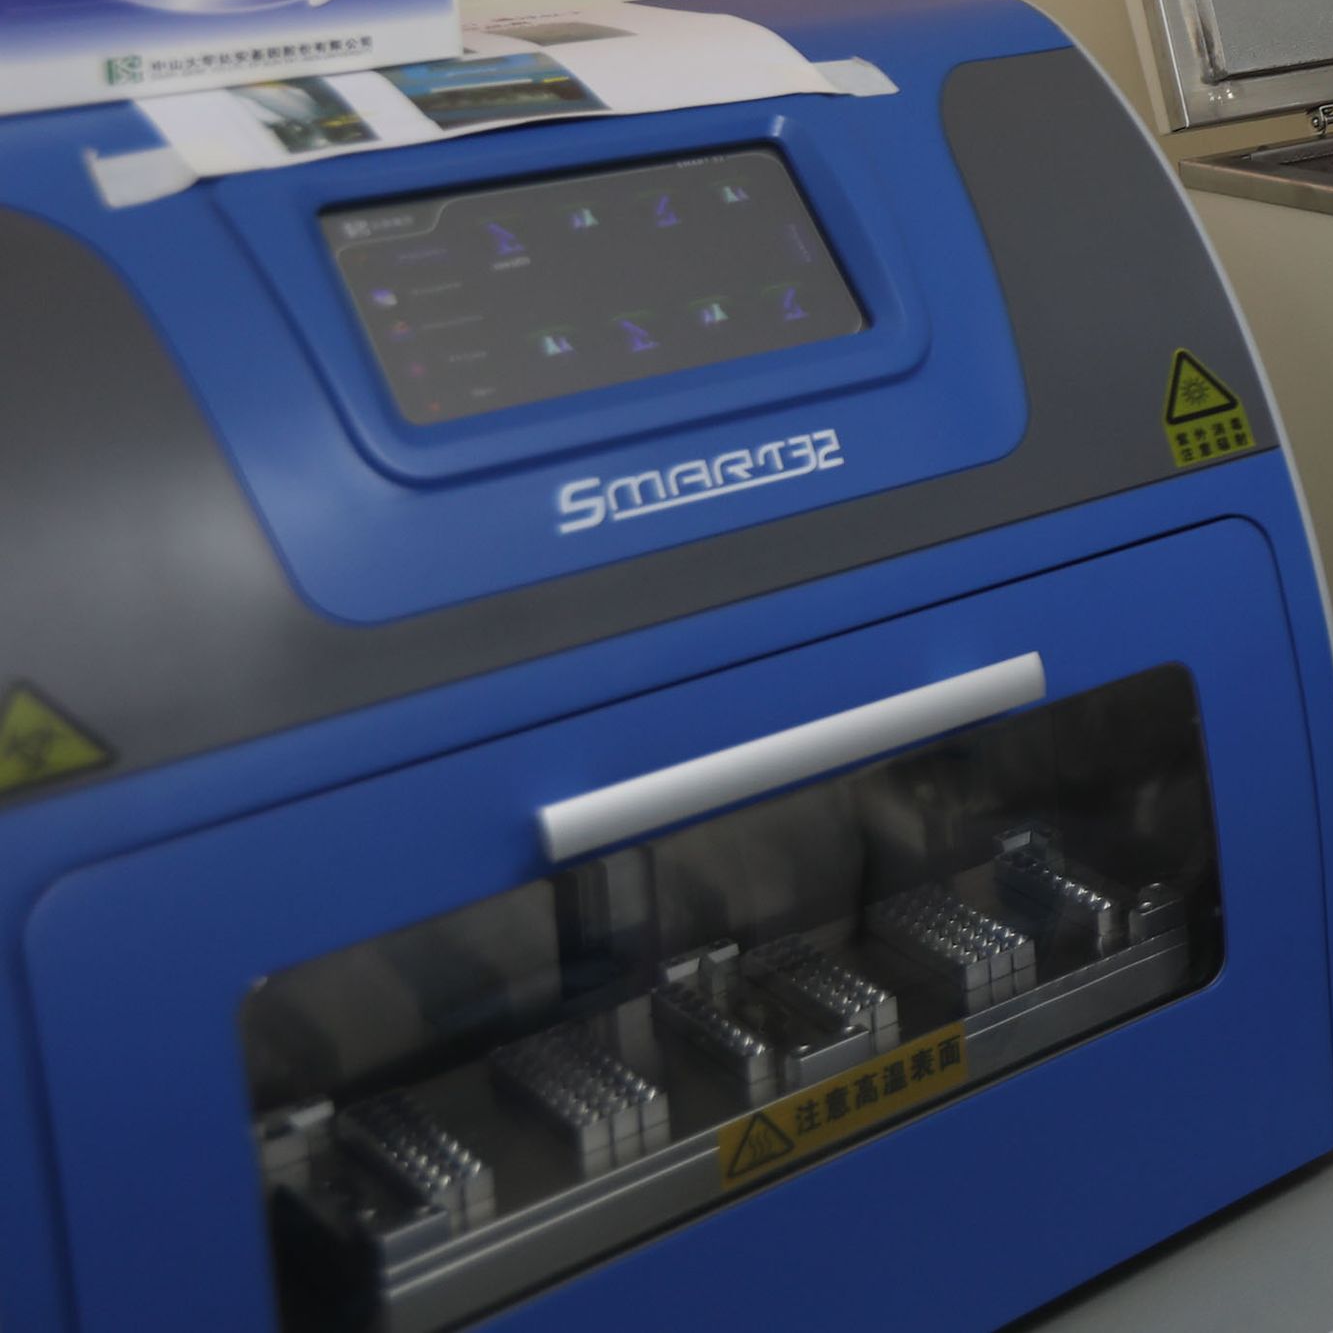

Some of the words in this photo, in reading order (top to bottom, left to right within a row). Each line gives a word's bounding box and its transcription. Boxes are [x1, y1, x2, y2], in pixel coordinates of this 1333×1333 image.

[795, 1034, 962, 1135] 注意高温表面
